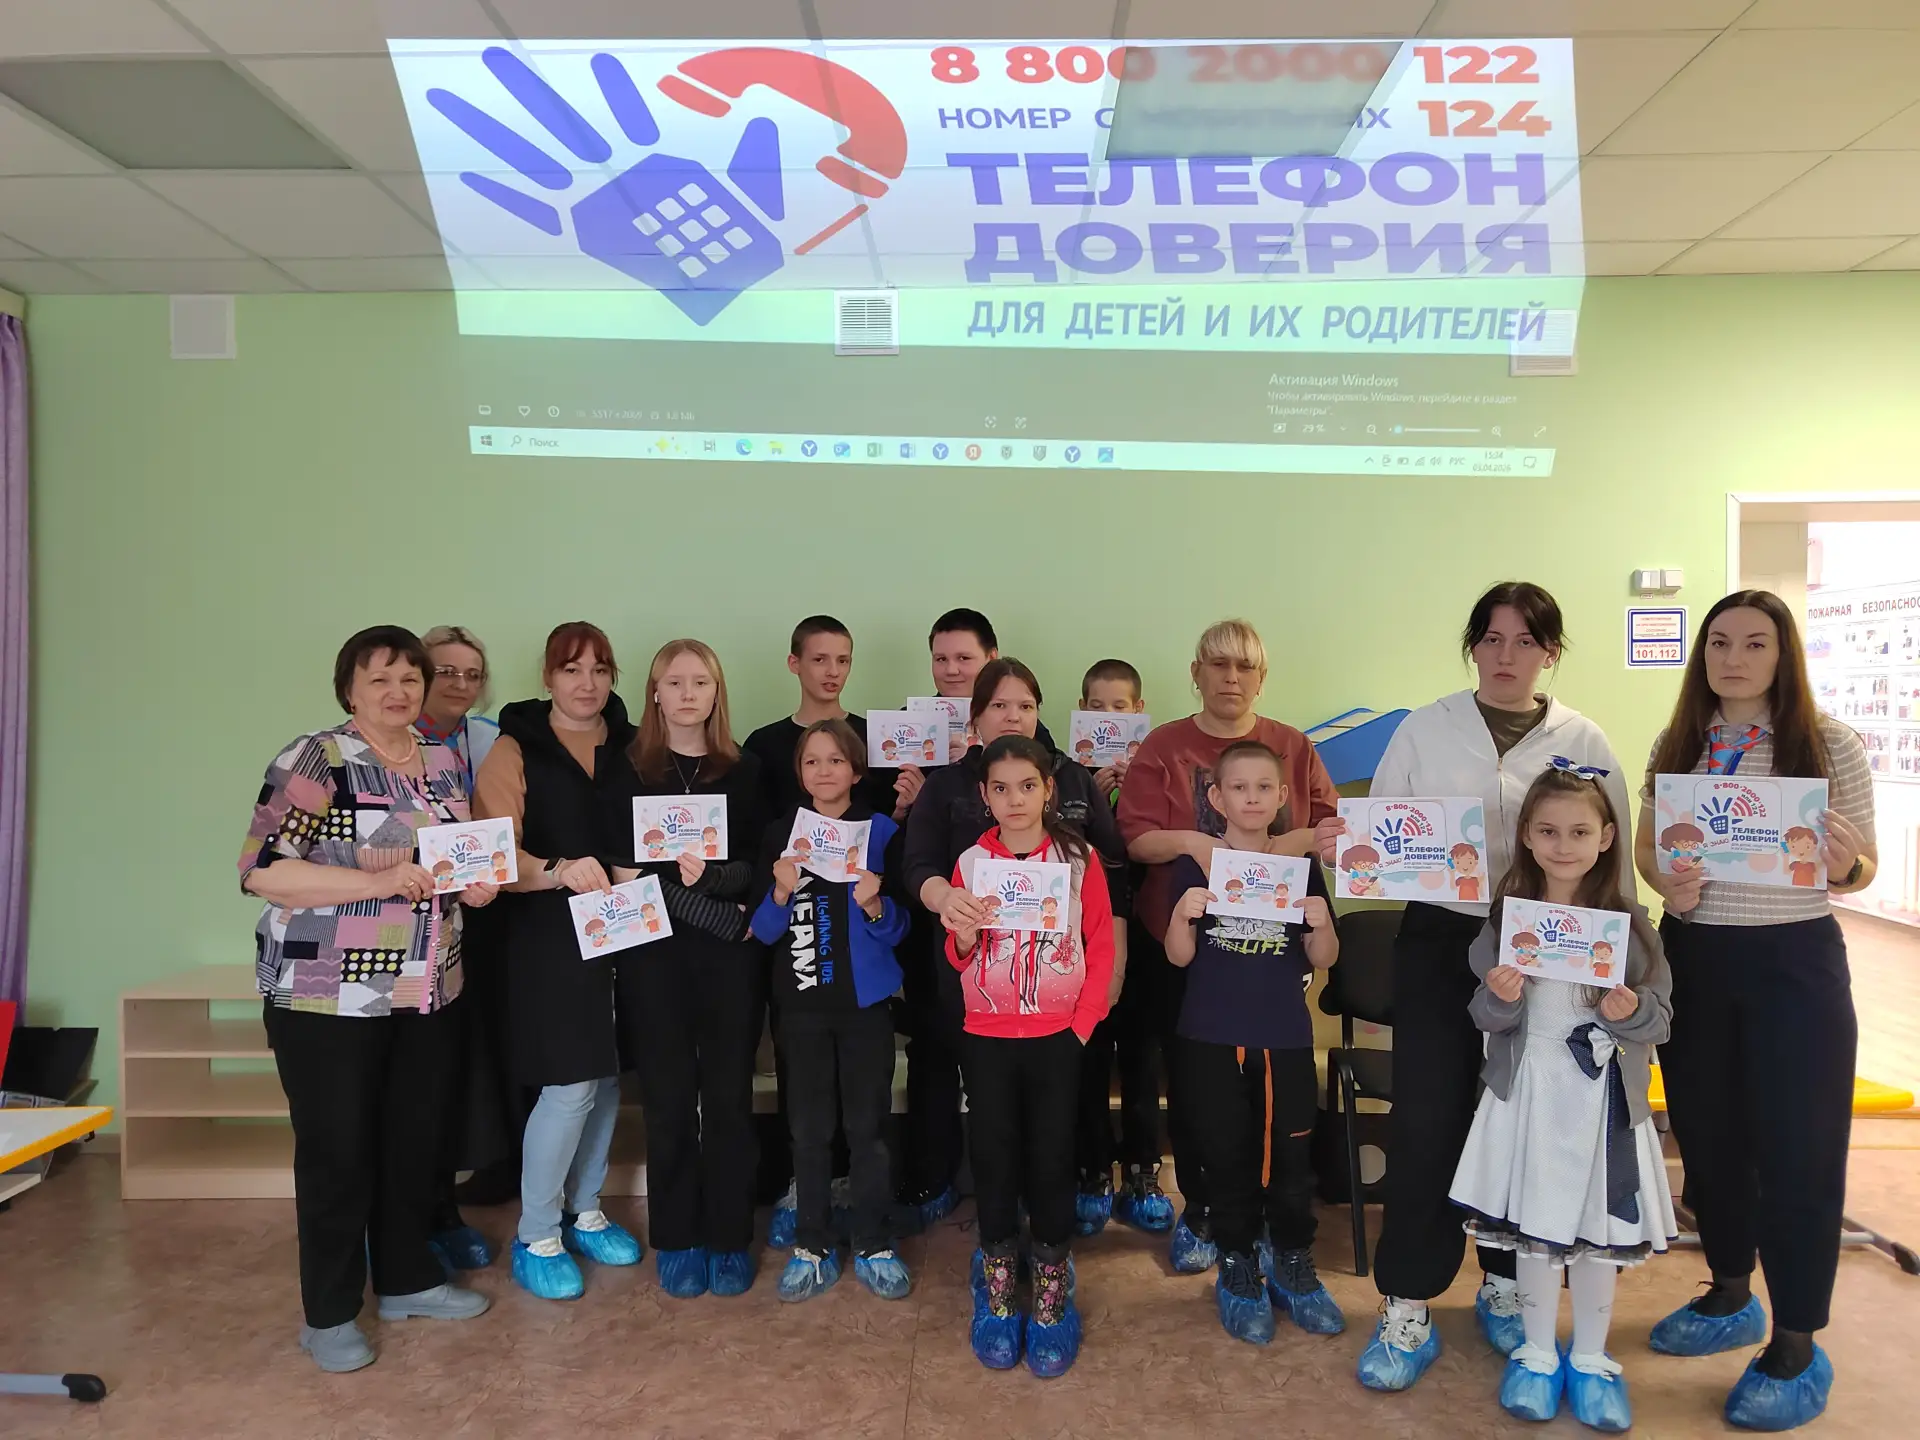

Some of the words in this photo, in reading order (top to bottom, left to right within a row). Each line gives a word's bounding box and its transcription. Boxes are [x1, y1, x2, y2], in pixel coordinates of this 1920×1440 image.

[930, 45, 980, 84] 8
[1005, 45, 1157, 84] 800
[1413, 45, 1540, 84] 122
[938, 107, 1072, 129] НОМЕР
[1417, 100, 1552, 137] 124
[946, 151, 1547, 208] ТЕЛЕФОН
[964, 221, 1552, 283] ДОВЕРИЯ
[967, 301, 1045, 339] ДЛЯ
[1065, 296, 1186, 340] ДЕТЕЙ
[1204, 304, 1231, 337] И
[1249, 304, 1303, 338] ИХ
[1321, 300, 1548, 344] РОДИТЕЛЕЙ
[1268, 373, 1339, 388] Активация
[1341, 373, 1399, 388] Windows
[529, 437, 559, 448] Поиск
[1808, 604, 1852, 619] ПОЖАРНАЯ
[1660, 649, 1677, 659] 112
[1731, 826, 1779, 836] ТЕЛЕФОН
[1731, 834, 1779, 843] ДОВЕРИЯ
[1403, 853, 1446, 861] ДОВЕРИЯ
